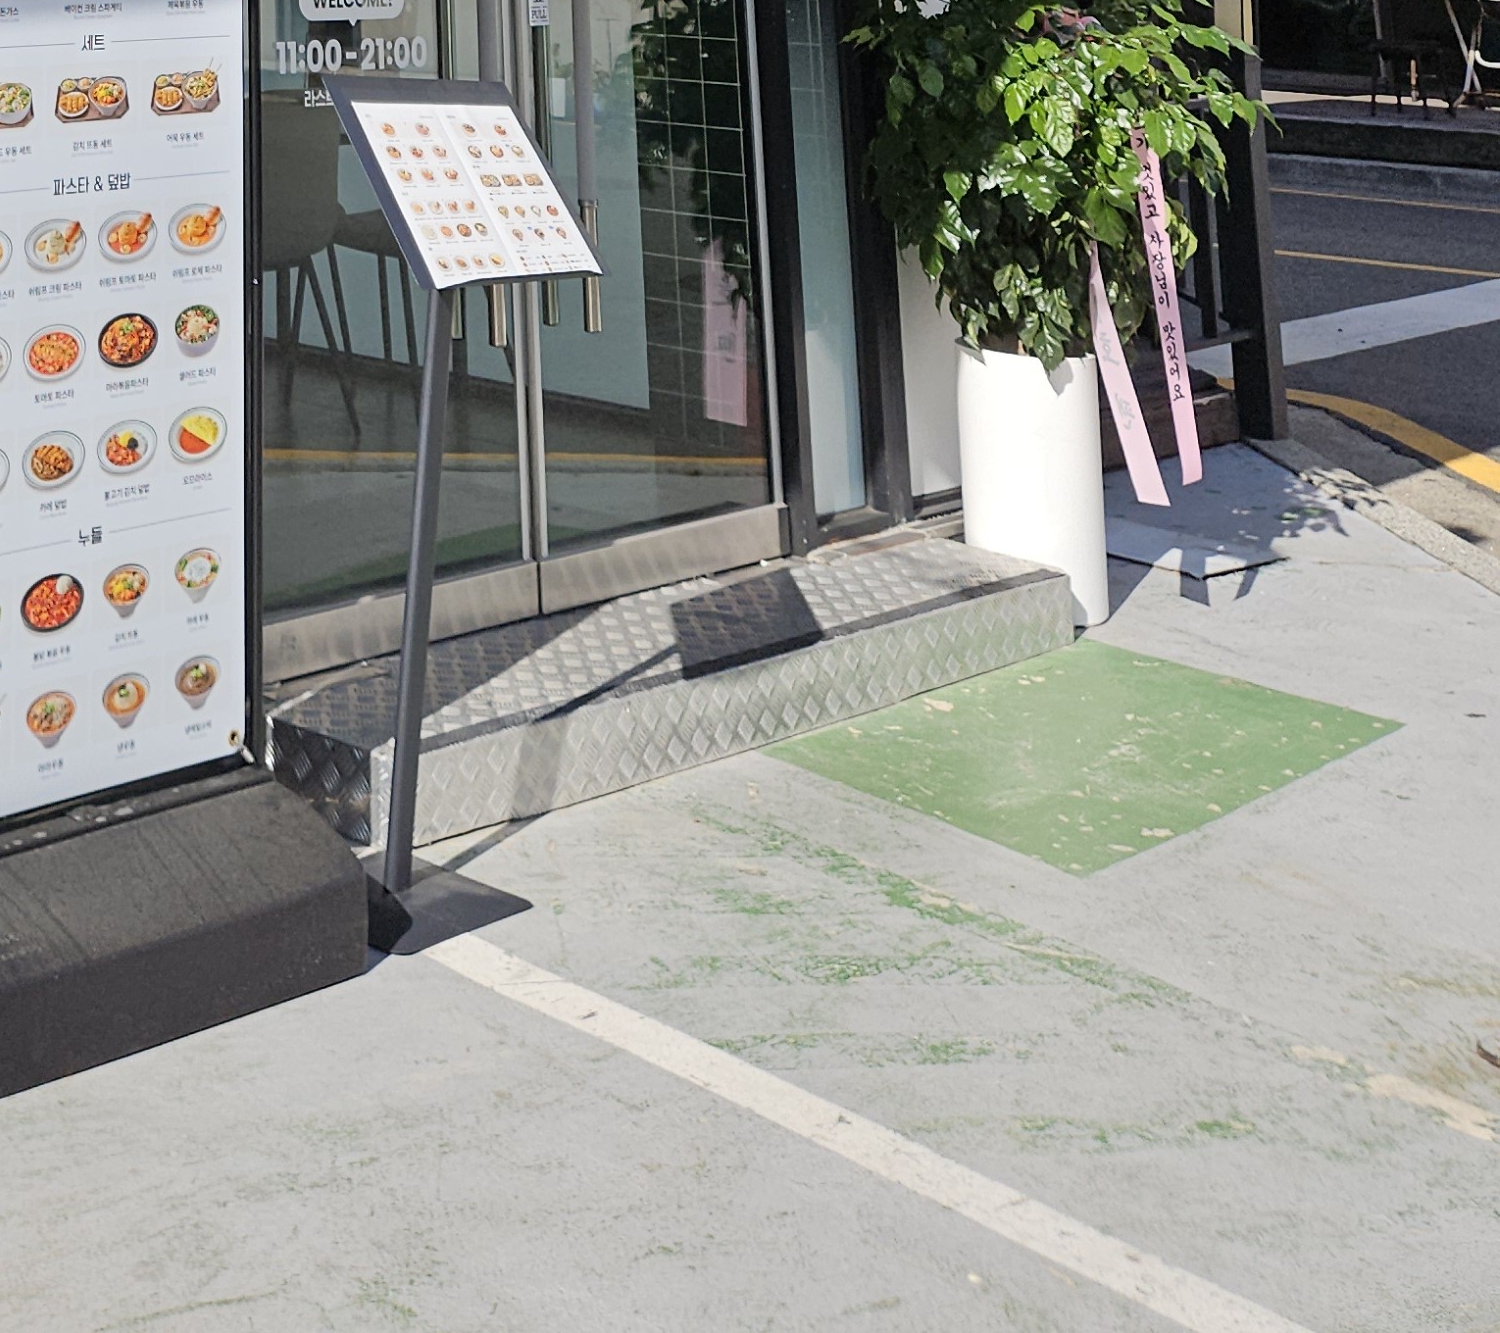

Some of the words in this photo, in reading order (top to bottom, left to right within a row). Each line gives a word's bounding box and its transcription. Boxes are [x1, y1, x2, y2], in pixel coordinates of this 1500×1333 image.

[82, 34, 106, 51] 세트
[53, 176, 90, 196] 파스타
[94, 176, 104, 192] &
[78, 525, 103, 547] 누들
